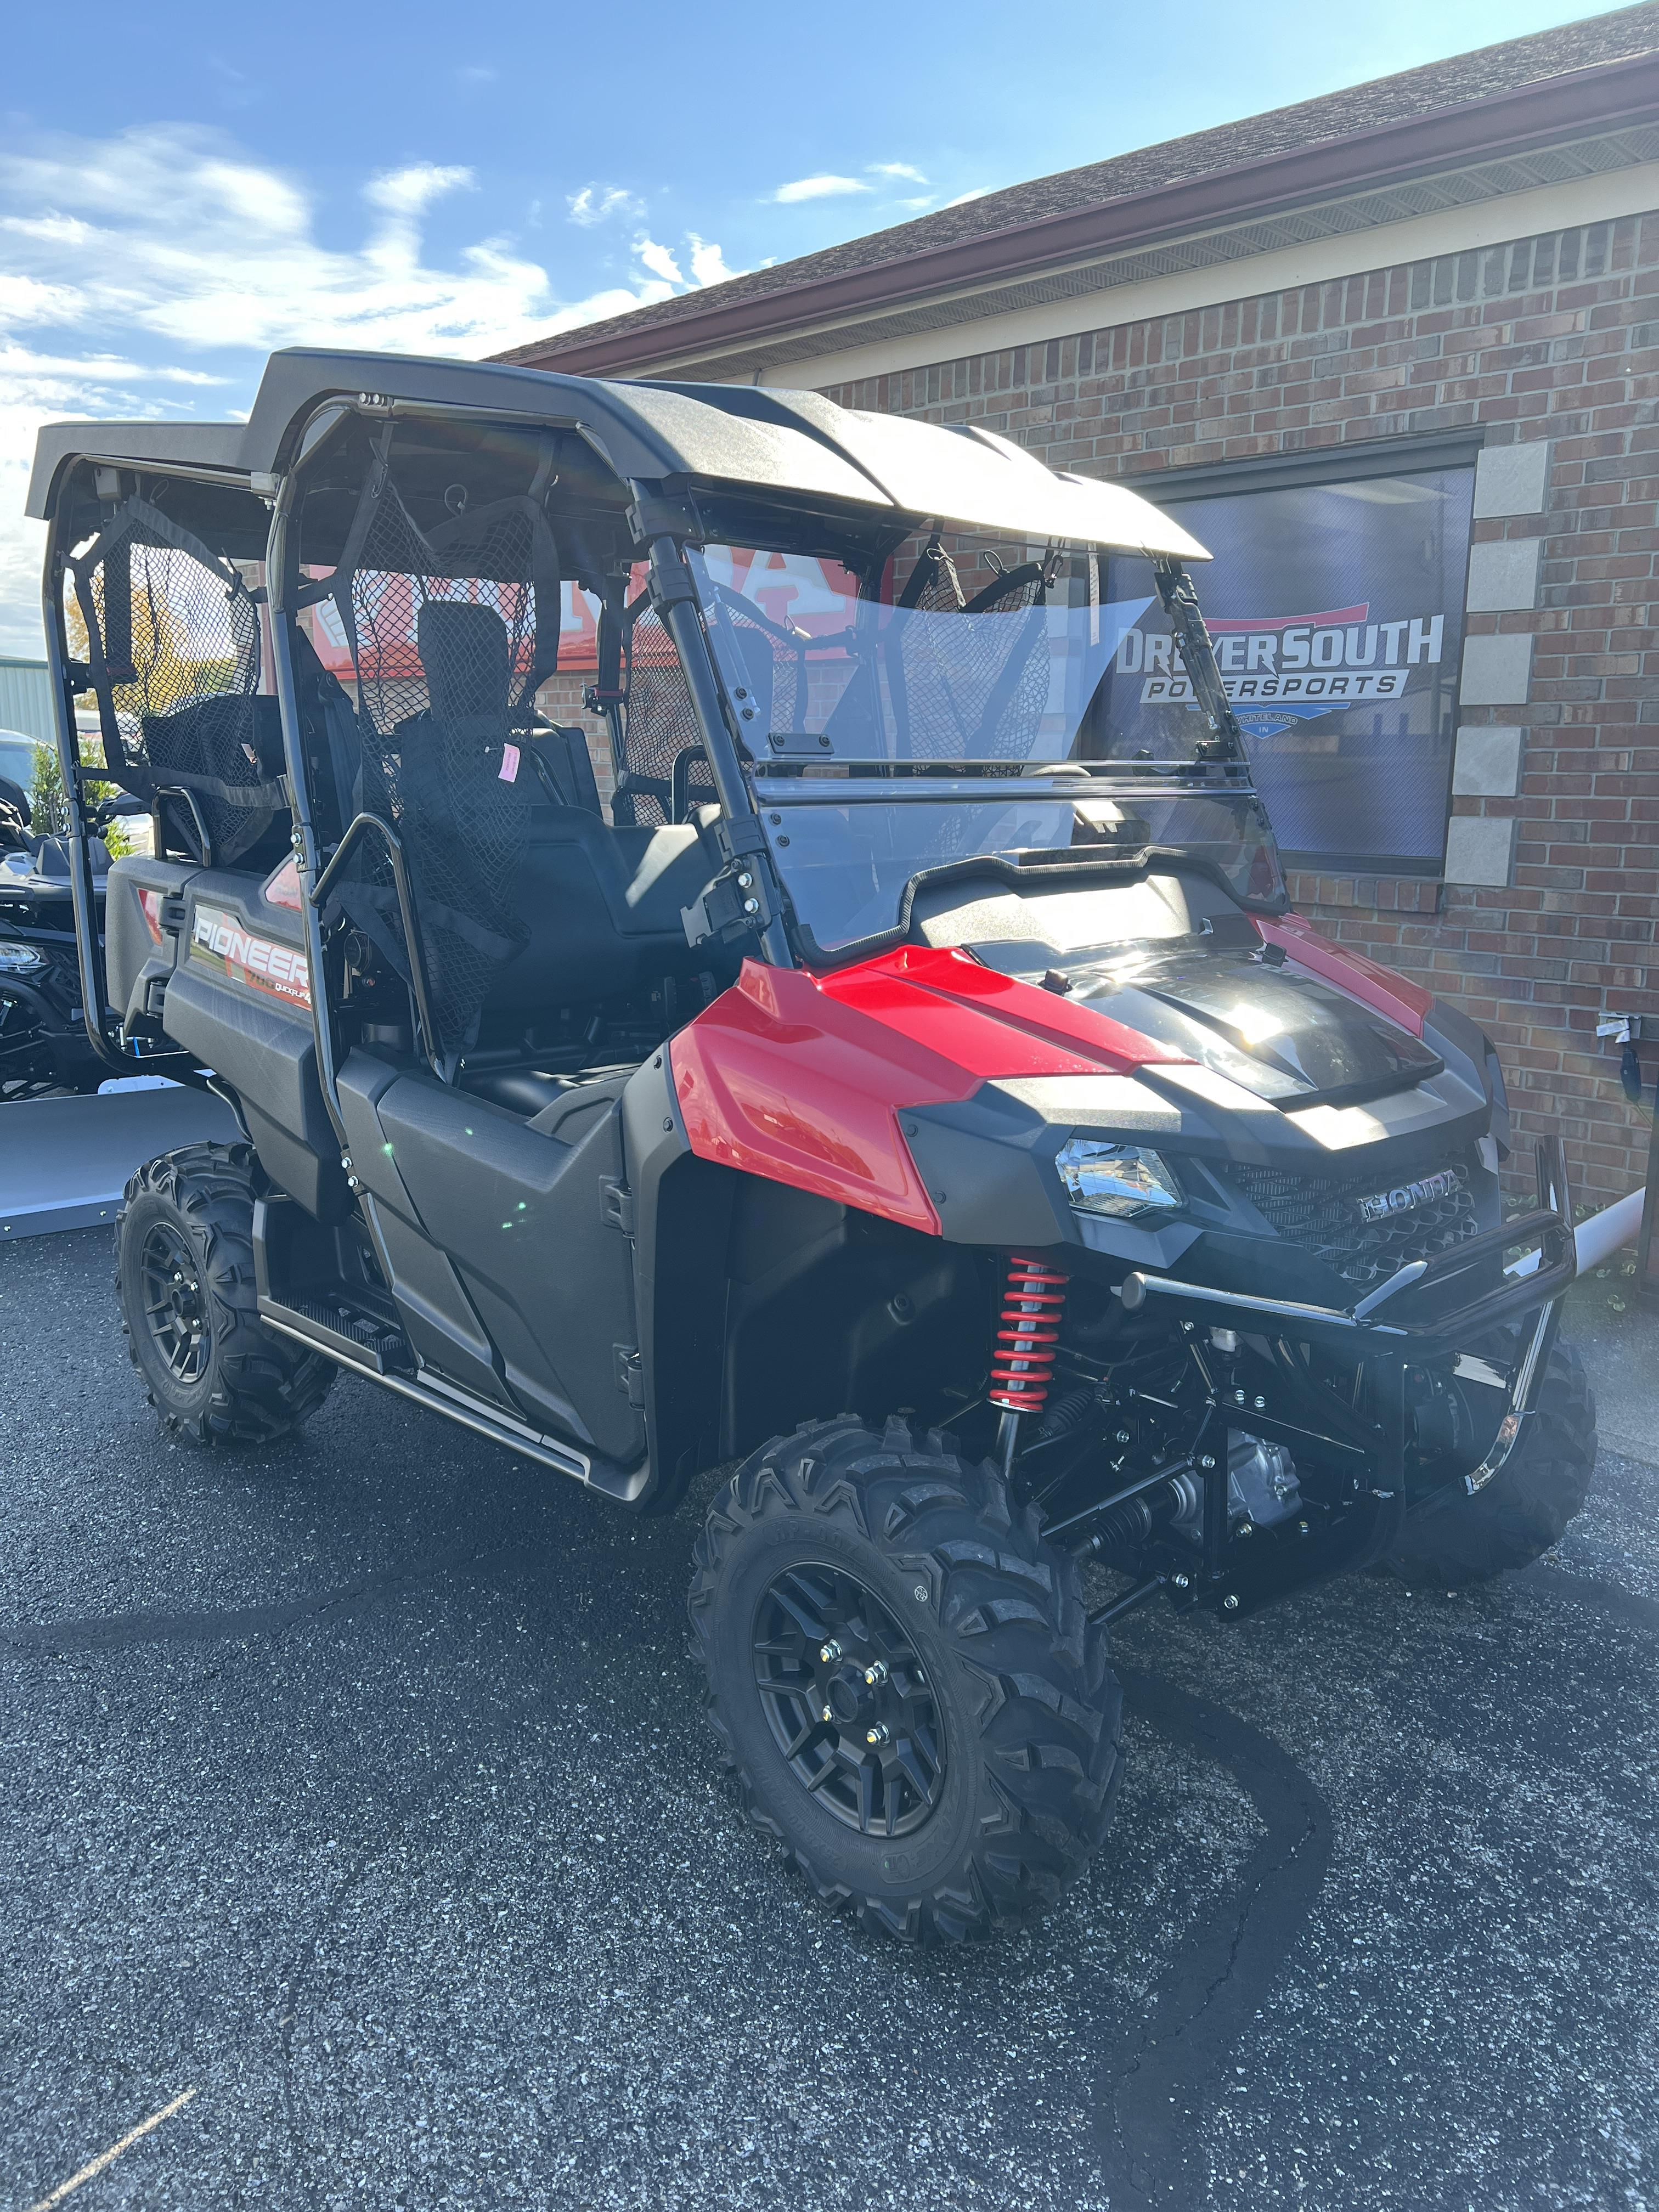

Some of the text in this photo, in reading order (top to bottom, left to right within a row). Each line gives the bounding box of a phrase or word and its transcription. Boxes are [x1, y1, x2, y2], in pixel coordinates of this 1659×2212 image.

[1147, 675, 1397, 698] POERSPORTS
[194, 917, 309, 988] PIONEER
[247, 969, 274, 991] 700
[1358, 1169, 1464, 1223] HONDA
